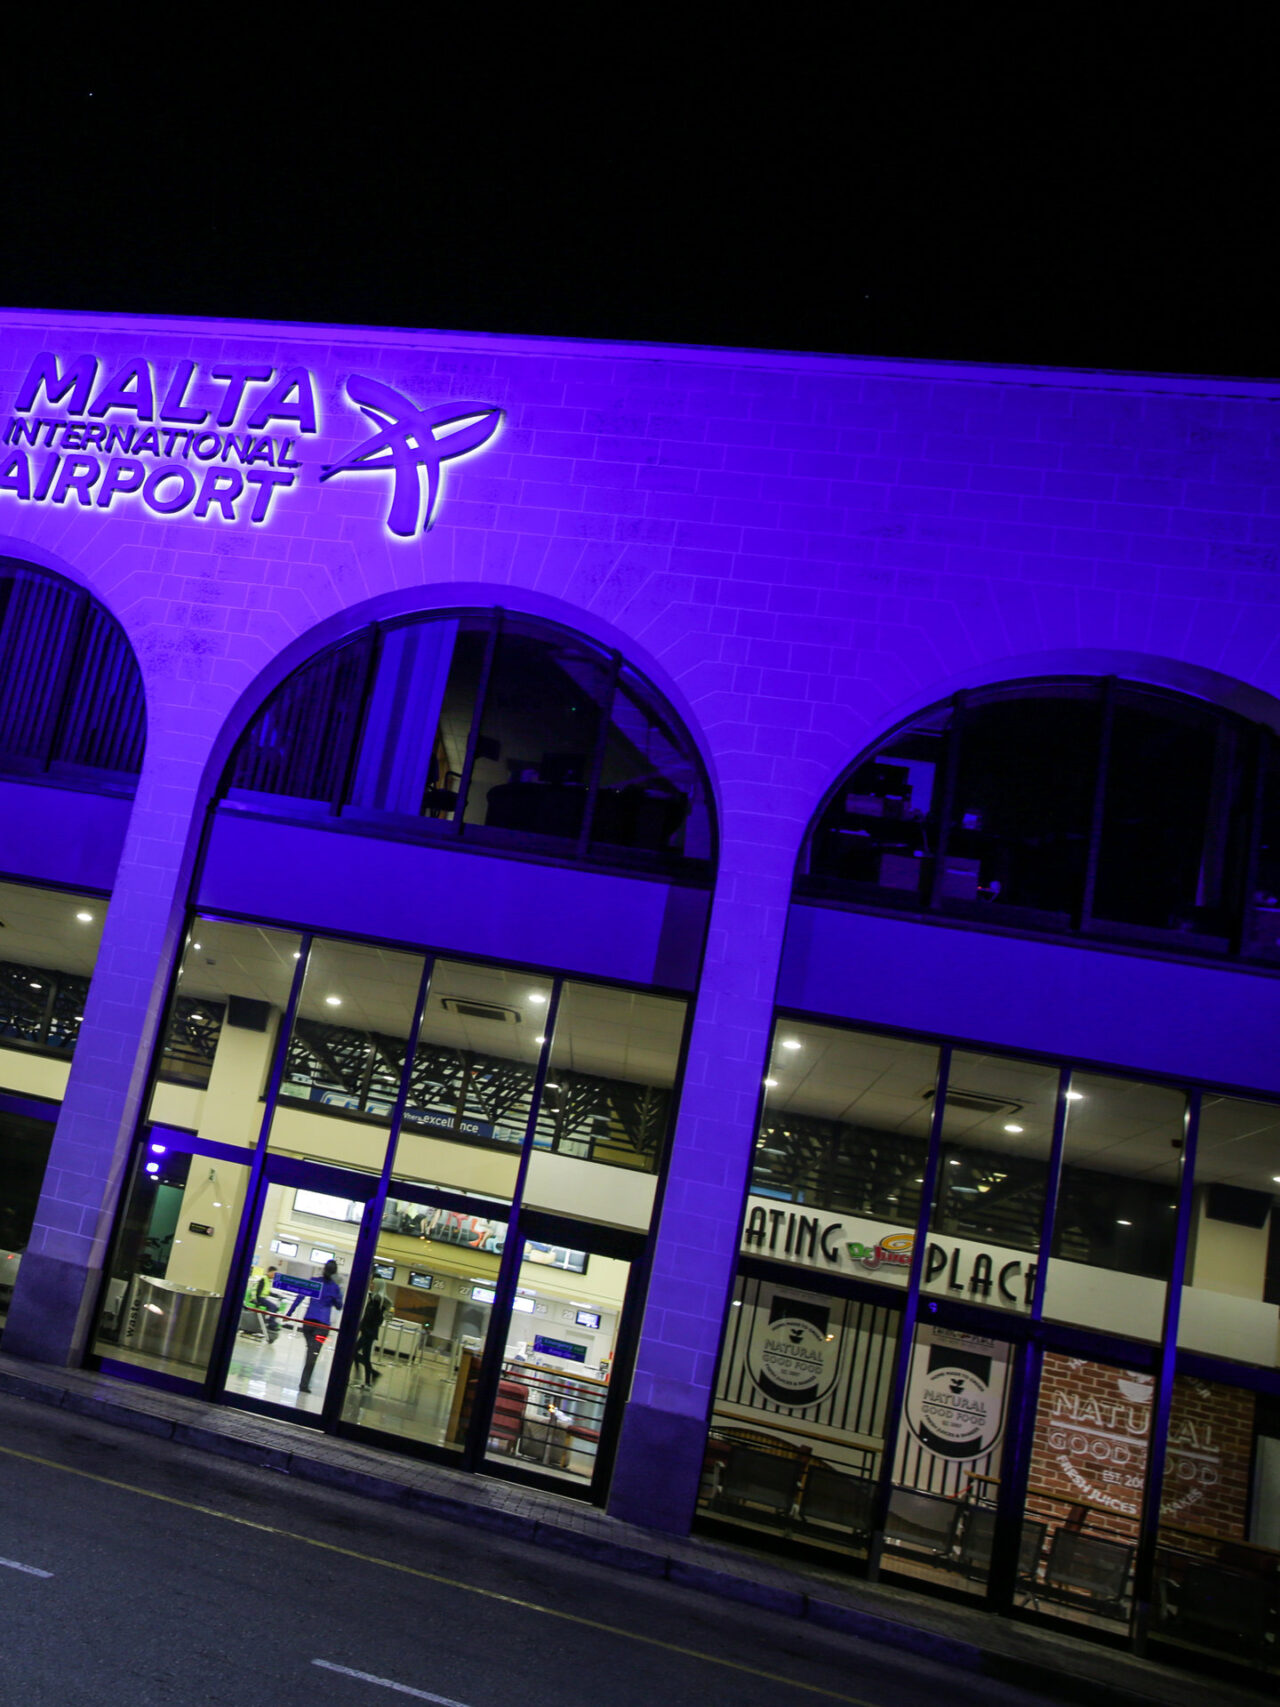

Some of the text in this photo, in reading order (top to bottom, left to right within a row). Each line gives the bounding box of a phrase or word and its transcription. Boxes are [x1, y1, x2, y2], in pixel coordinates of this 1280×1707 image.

[14, 351, 317, 434] MALTA
[2, 417, 303, 468] INTERNATIONAL
[423, 1115, 479, 1133] excellnce
[745, 1206, 842, 1262] ATING
[762, 1354, 794, 1368] GOOD
[794, 1362, 823, 1375] FOOD
[764, 1339, 824, 1363] NATURAL
[921, 1404, 954, 1419] GOOD
[956, 1413, 986, 1426] FOOD
[923, 1388, 987, 1413] NATURAL
[1048, 1431, 1131, 1465] GOOD
[1056, 1454, 1092, 1494] FRESH
[1087, 1488, 1137, 1515] JUICES
